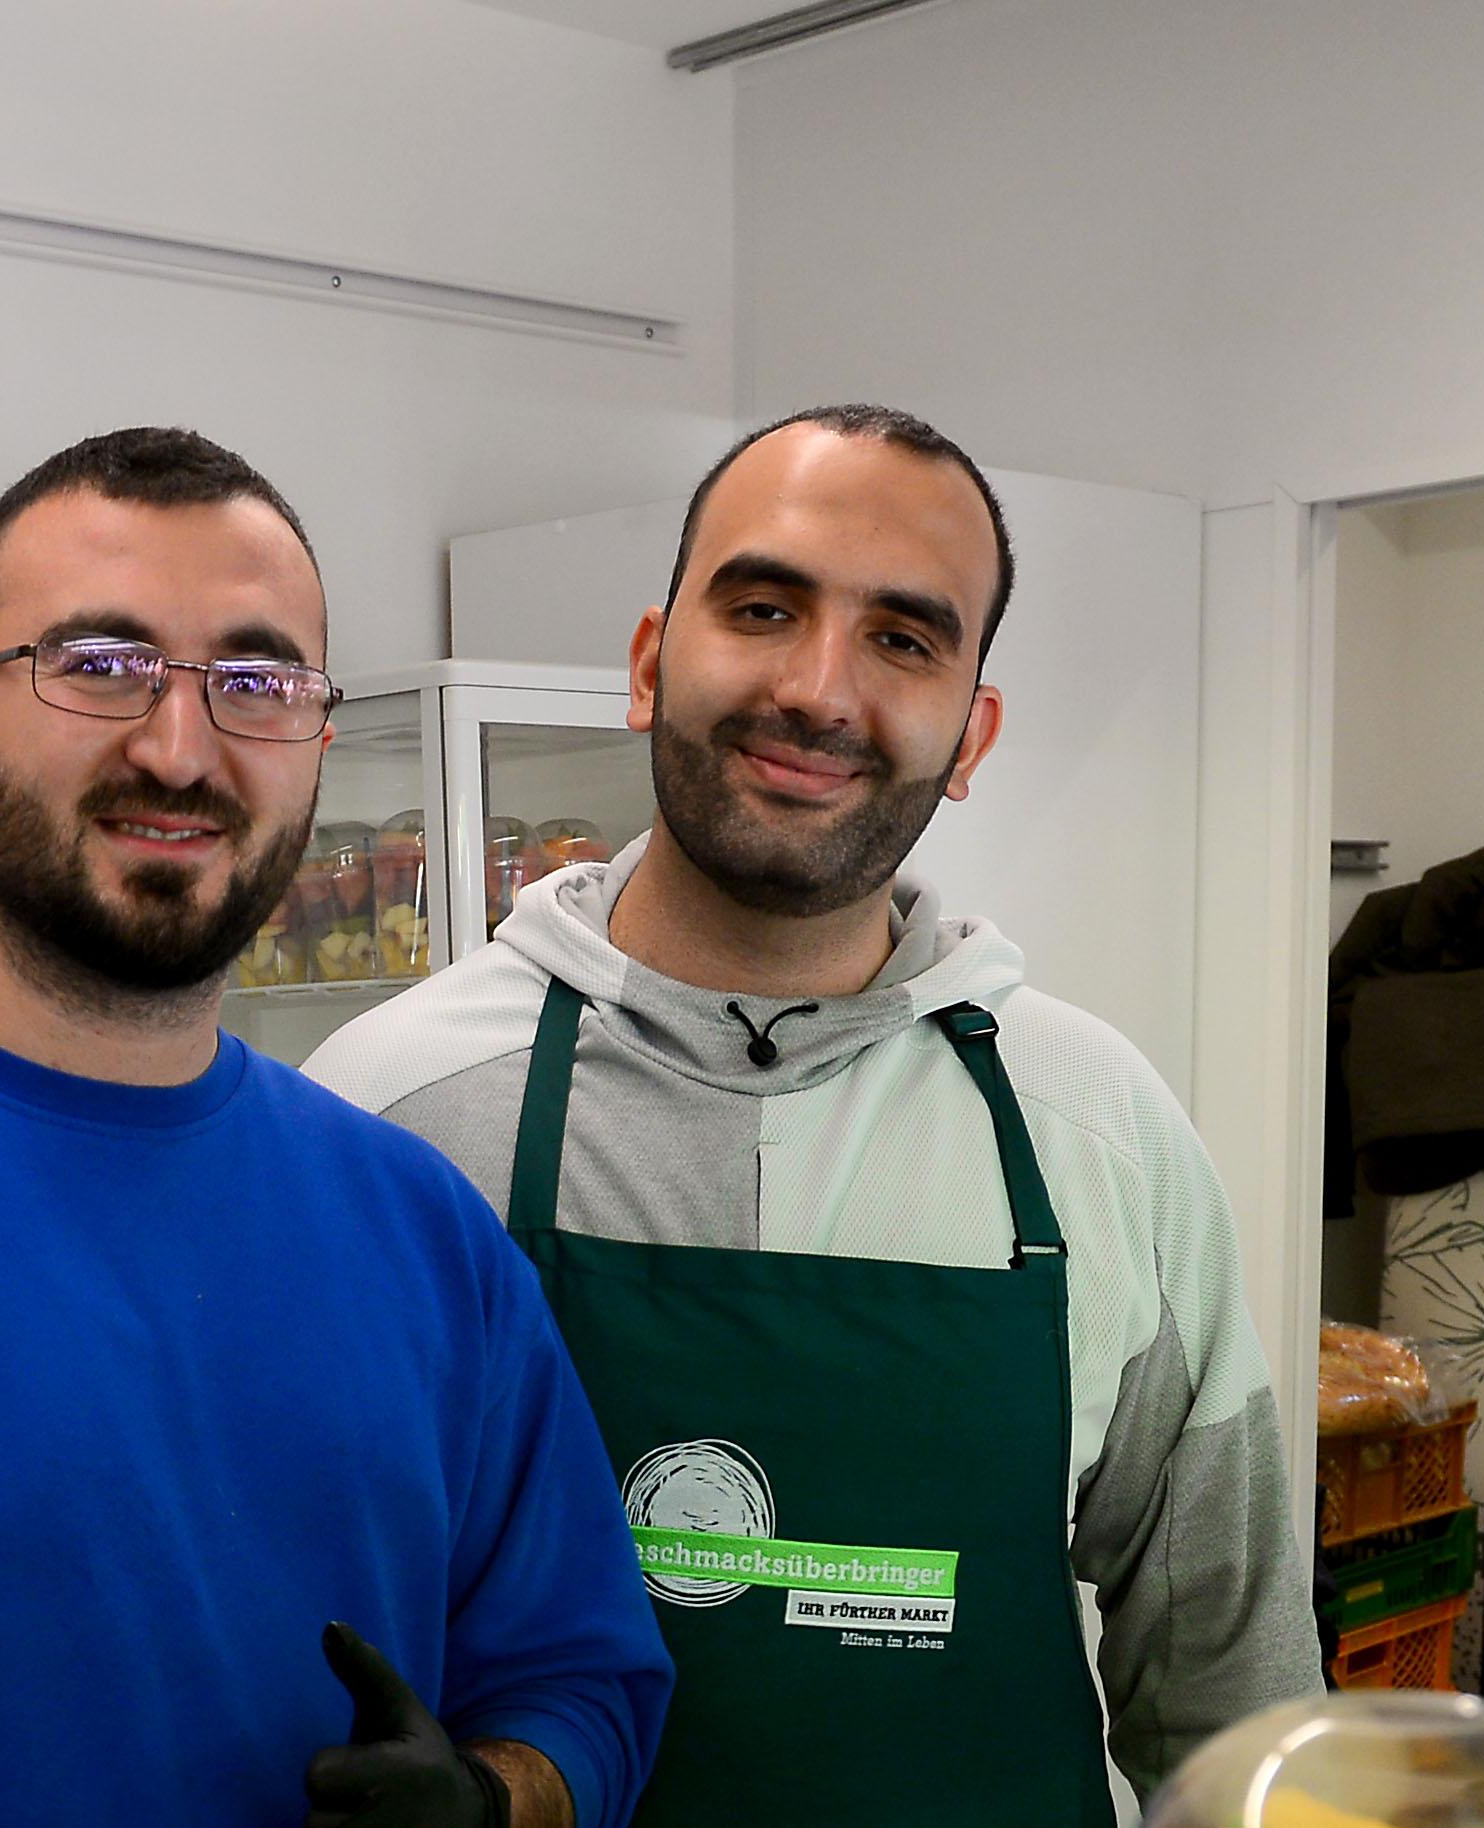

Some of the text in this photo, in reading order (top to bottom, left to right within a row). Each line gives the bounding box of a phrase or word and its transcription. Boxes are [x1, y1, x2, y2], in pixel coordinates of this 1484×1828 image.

[634, 1541, 946, 1590] eschmacksüberbringer
[797, 1602, 950, 1622] IHR FÜRTHER MARKT
[840, 1631, 946, 1650] Mitten im Leben
